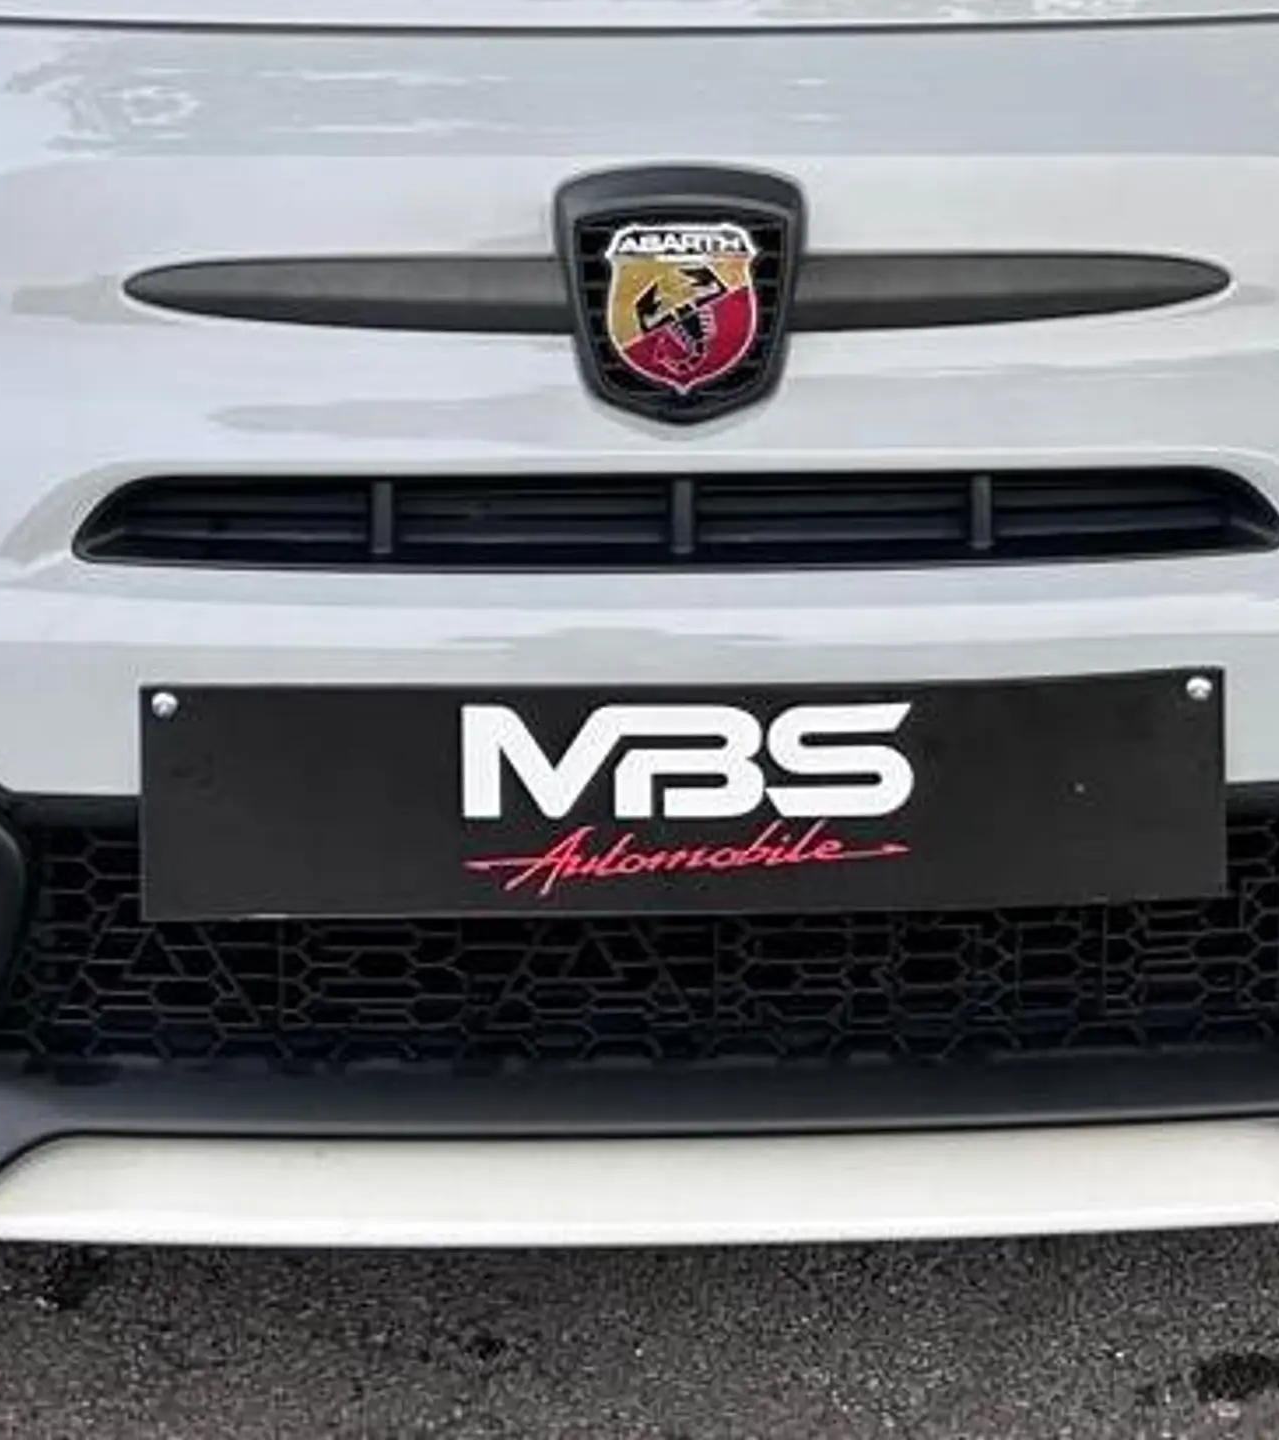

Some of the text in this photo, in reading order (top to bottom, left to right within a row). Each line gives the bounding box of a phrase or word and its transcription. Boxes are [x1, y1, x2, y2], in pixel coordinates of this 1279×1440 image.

[619, 234, 740, 253] ABARTH
[461, 702, 915, 821] MBS
[463, 816, 912, 898] Automobile
